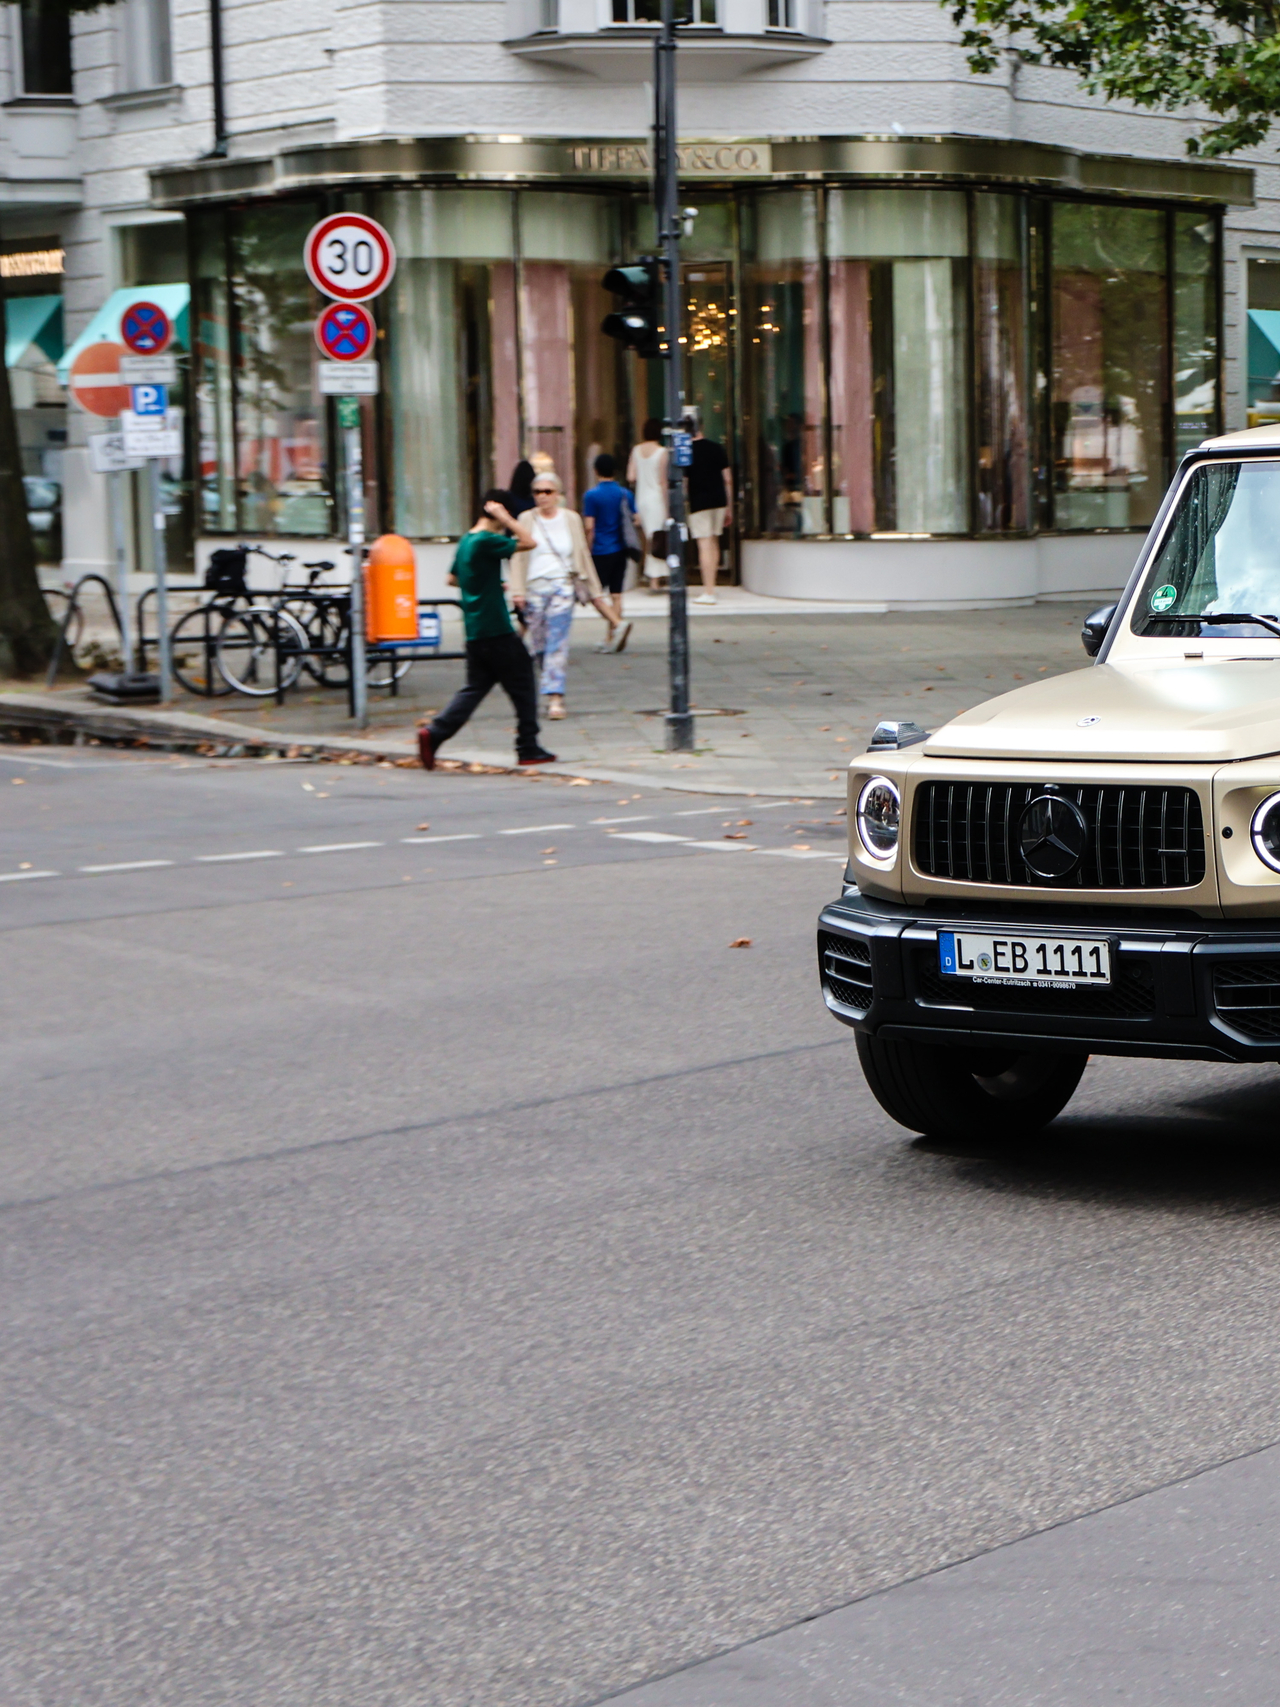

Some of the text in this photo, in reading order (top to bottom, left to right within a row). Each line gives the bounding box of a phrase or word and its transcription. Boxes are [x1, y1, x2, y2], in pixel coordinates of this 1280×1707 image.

[566, 146, 761, 170] TIFFAY&CO.
[327, 239, 373, 276] 30
[945, 956, 952, 966] D
[957, 938, 1106, 978] L EB 1111
